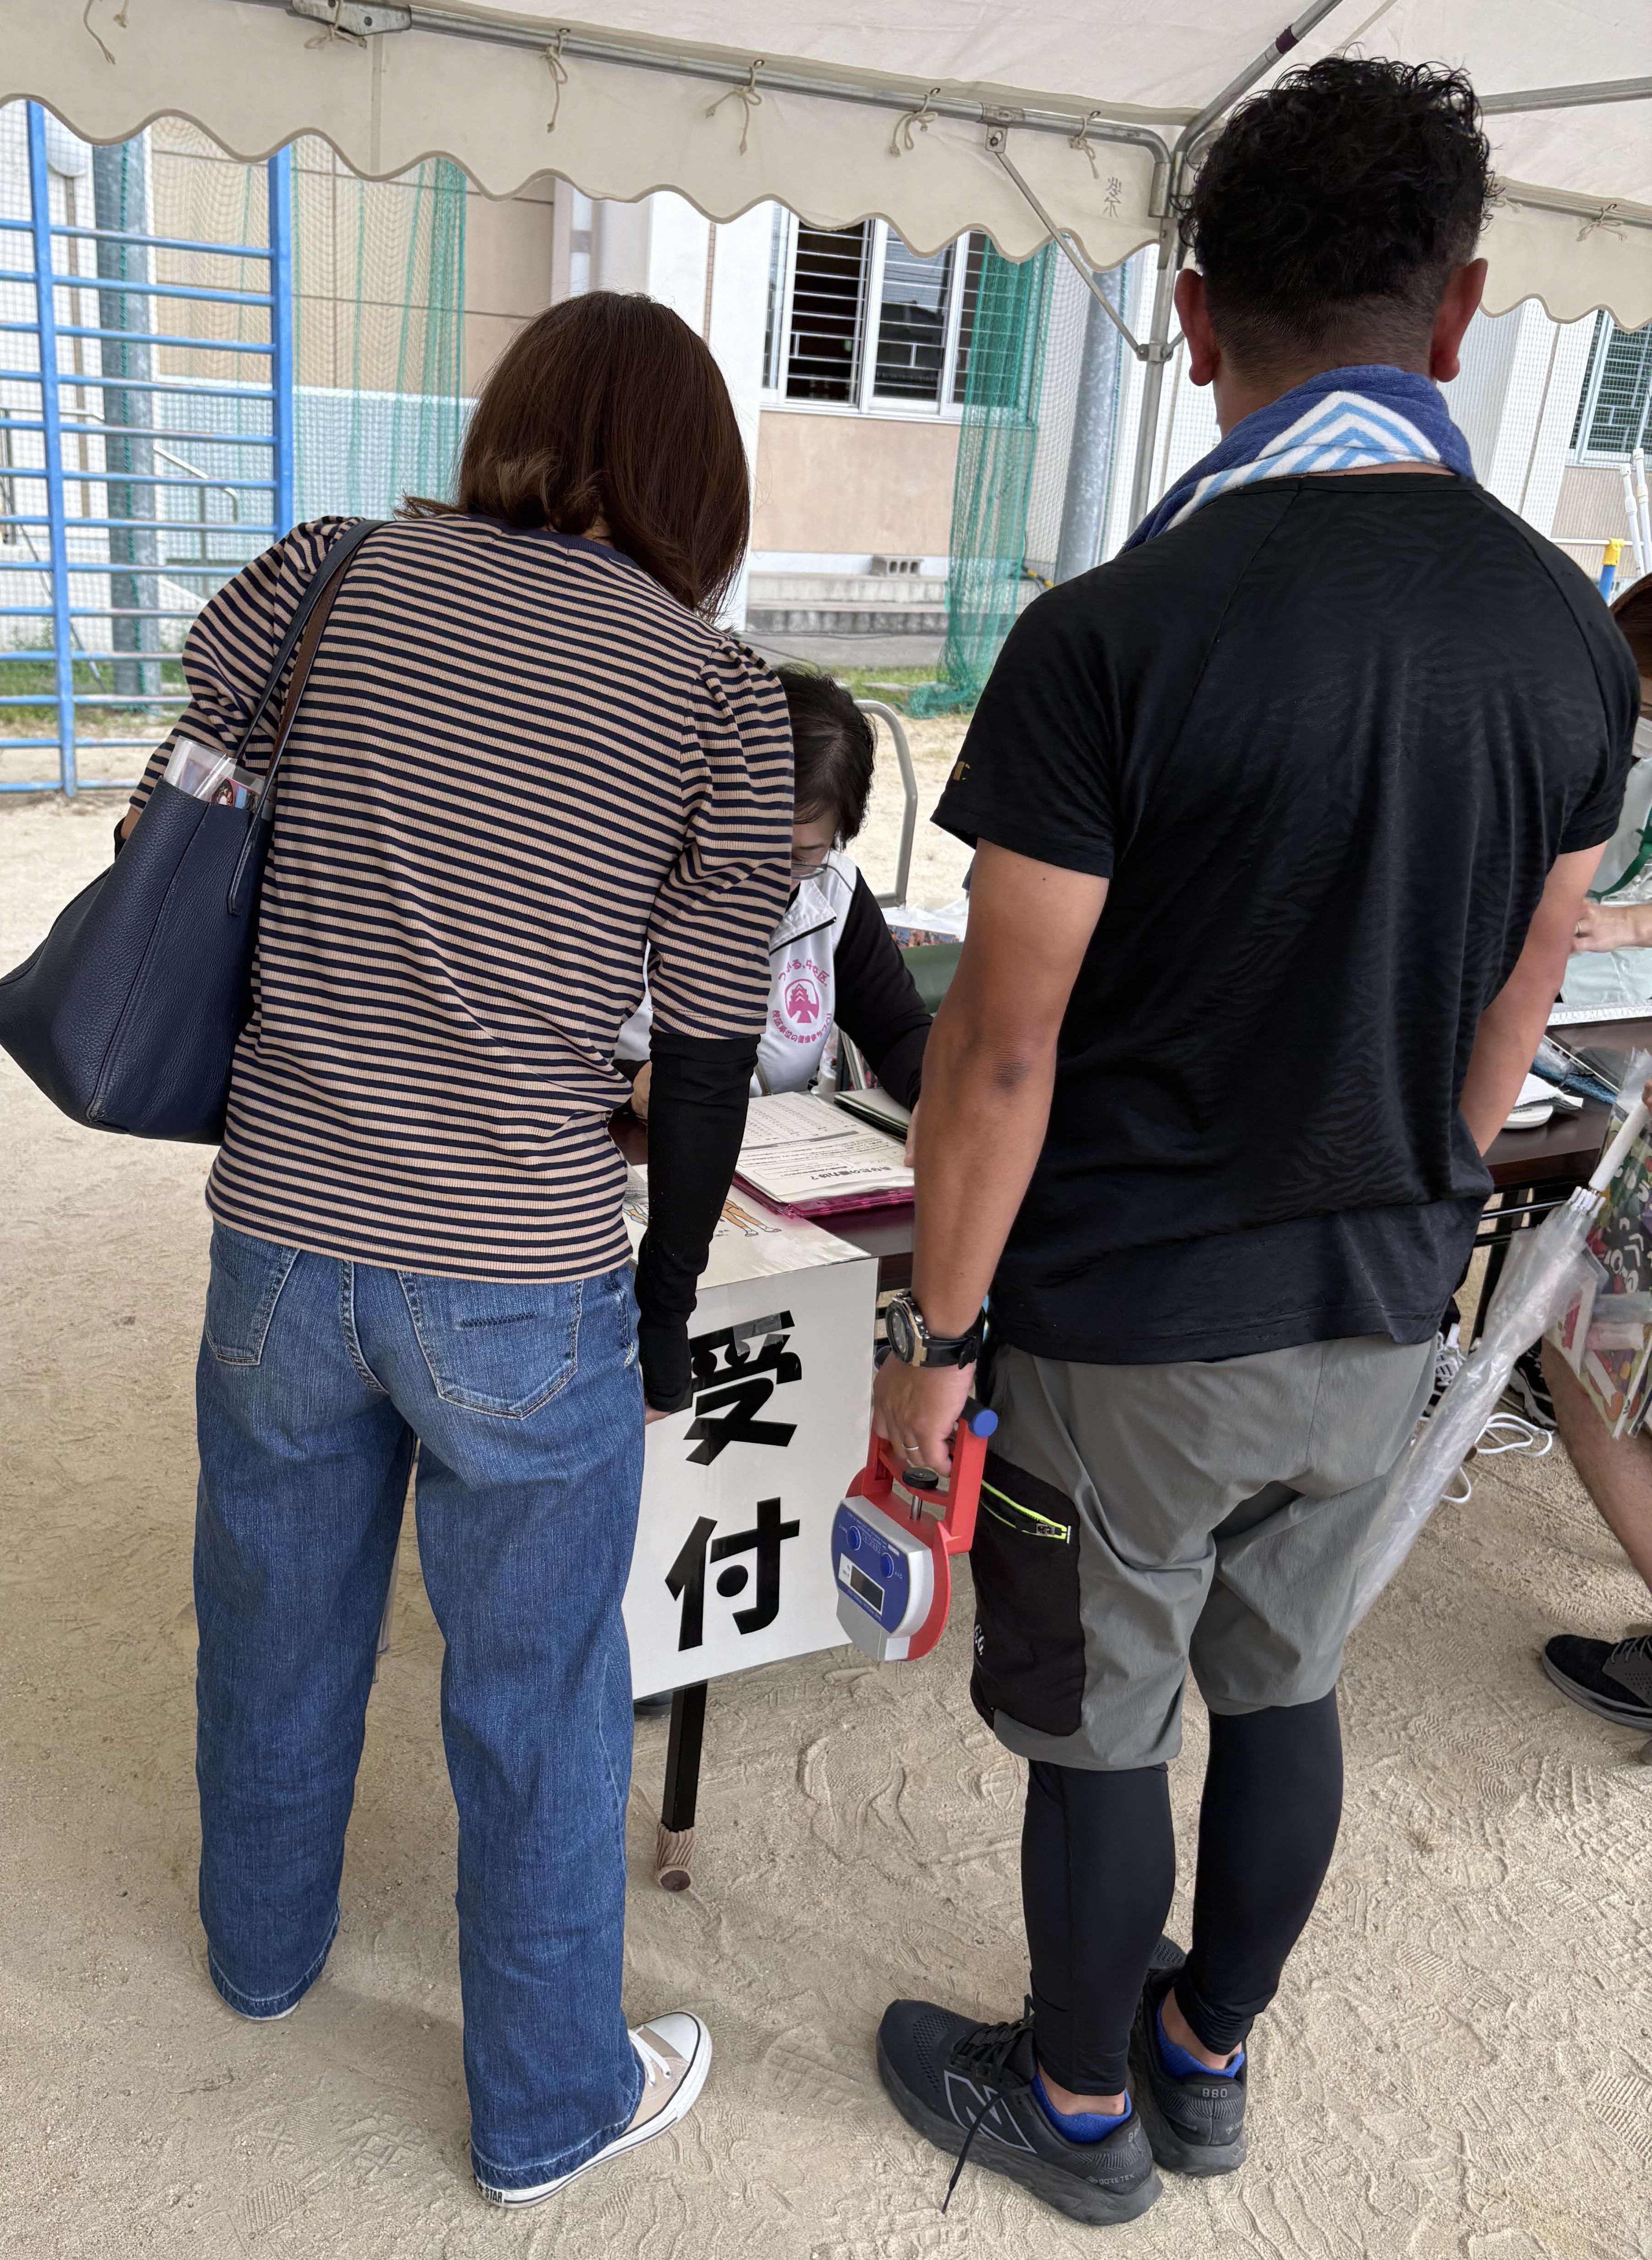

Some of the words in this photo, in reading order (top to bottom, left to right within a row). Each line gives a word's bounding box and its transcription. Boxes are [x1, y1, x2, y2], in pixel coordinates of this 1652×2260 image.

[665, 1310, 802, 1652] 受付
[1202, 2088, 1228, 2098] 880
[485, 2186, 502, 2204] STAR
